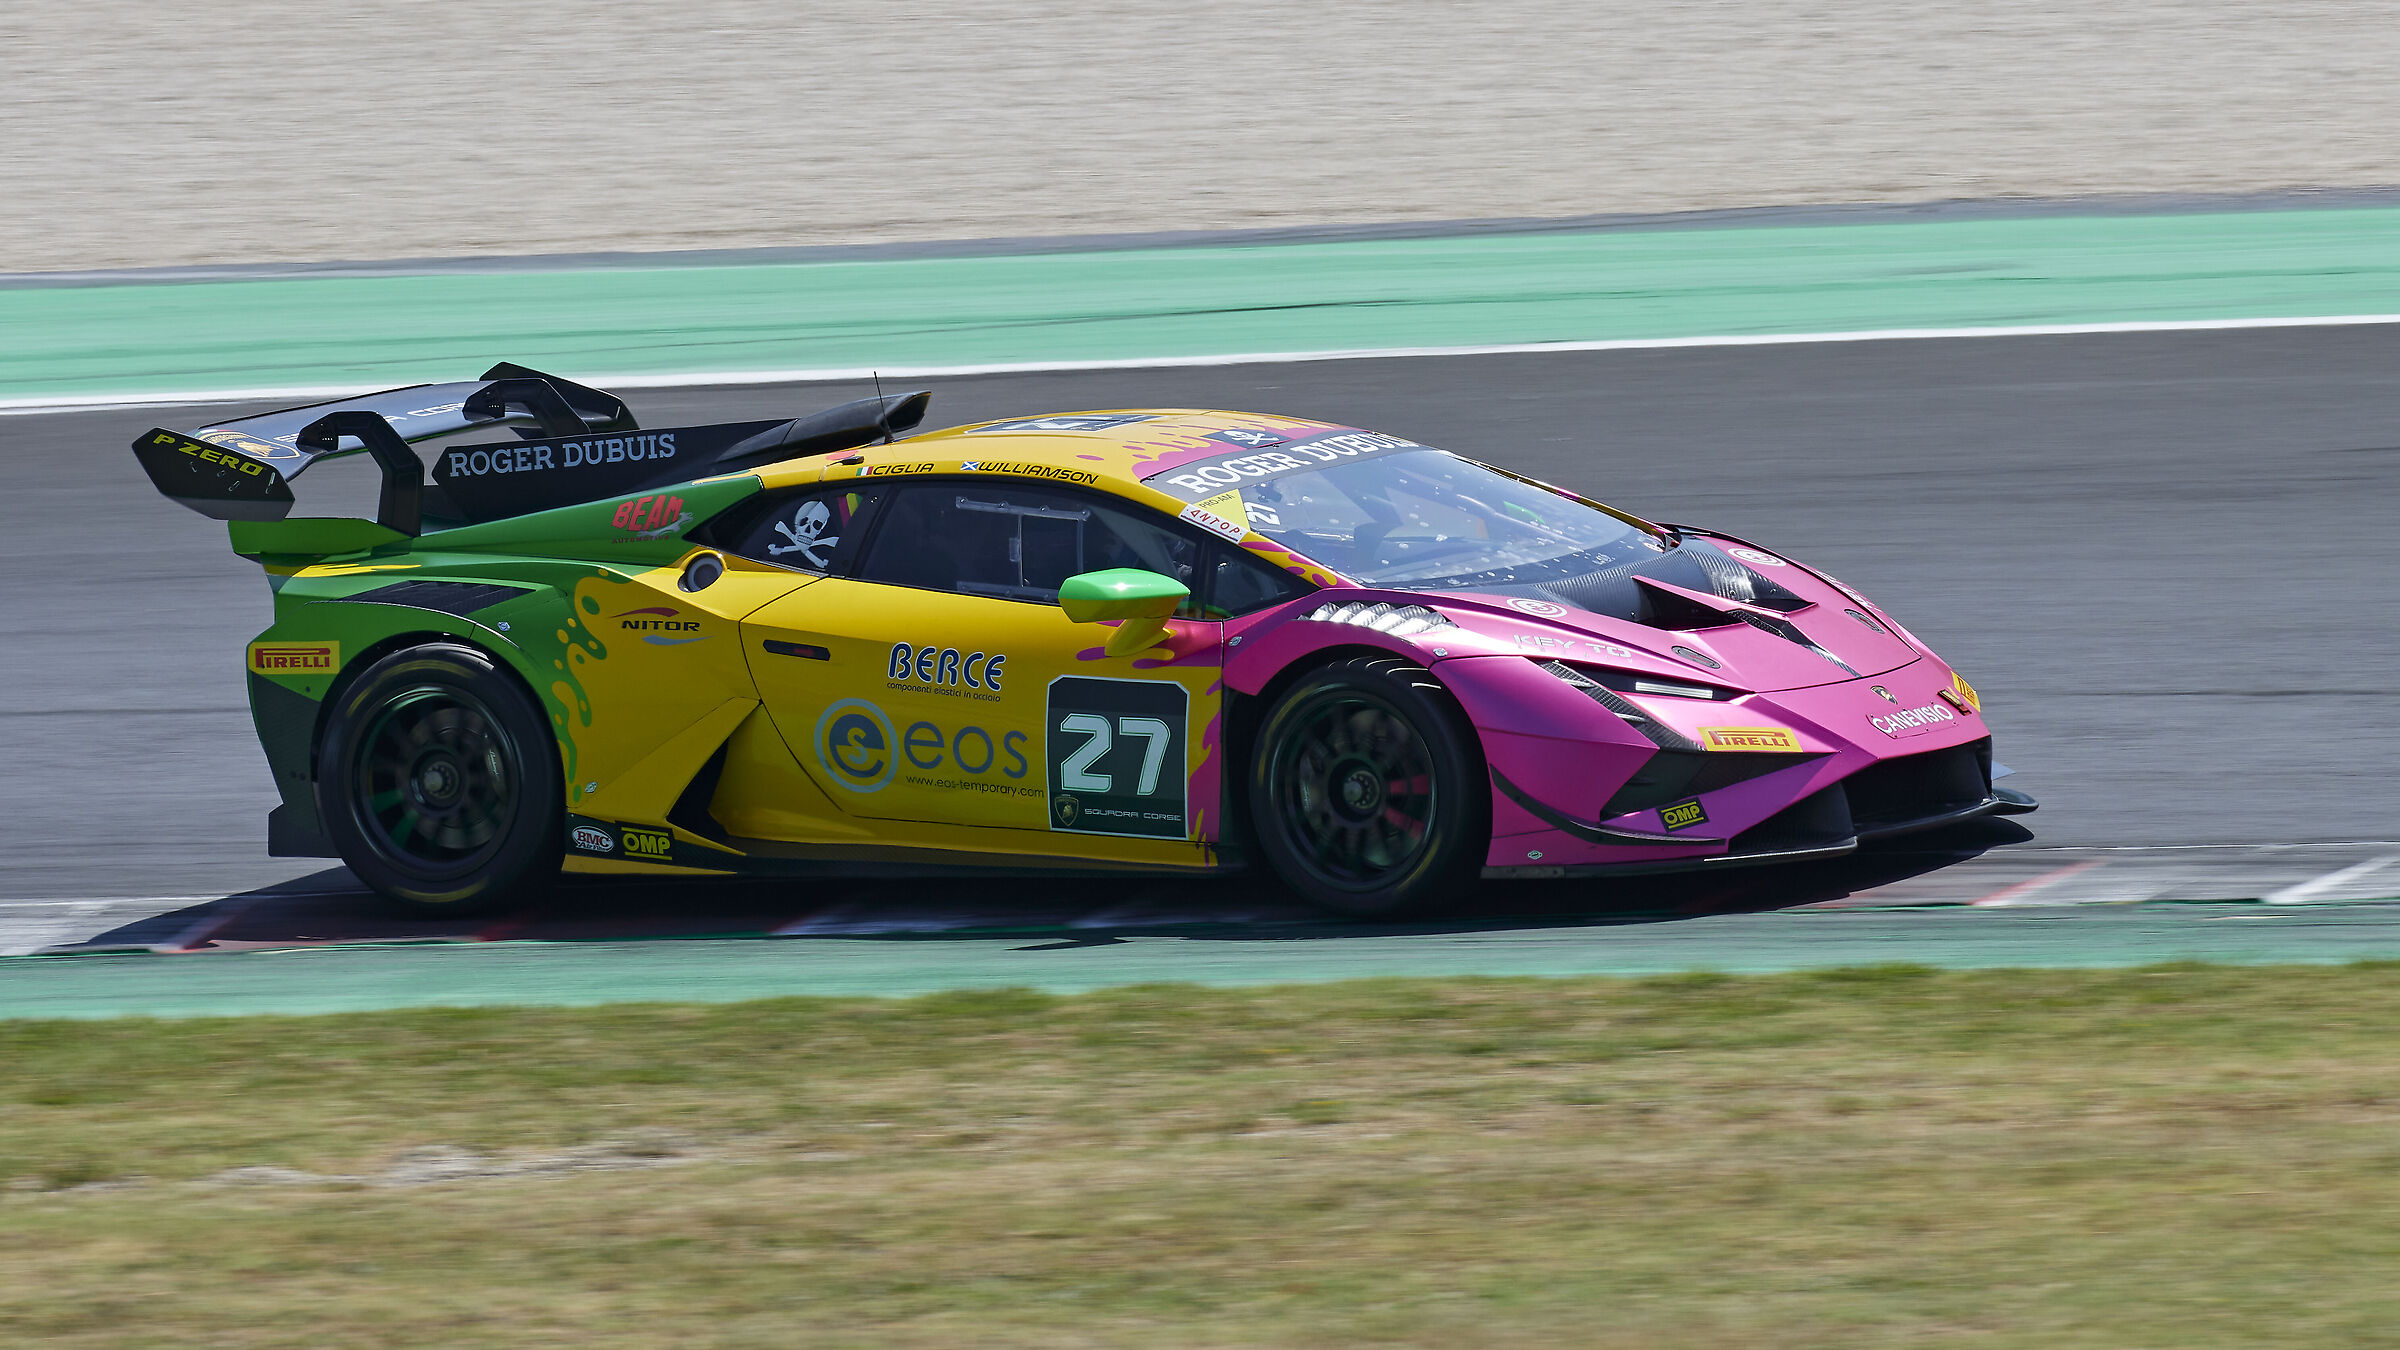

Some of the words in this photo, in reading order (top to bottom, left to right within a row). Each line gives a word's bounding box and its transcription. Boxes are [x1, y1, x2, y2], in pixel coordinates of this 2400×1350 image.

[153, 433, 176, 445] P
[178, 441, 264, 477] ZERO
[449, 445, 555, 477] ROGER
[562, 433, 676, 468] DUBUIS
[872, 463, 935, 476] CIGLIA
[978, 461, 1100, 485] WILLIAMSON
[1166, 452, 1313, 494] ROGER
[611, 494, 685, 532] BEAM
[622, 620, 701, 632] NITOR
[255, 647, 331, 669] PIRELLI
[1513, 634, 1576, 649] KEY
[1585, 642, 1632, 658] TO
[887, 641, 1007, 692] BERCE
[886, 682, 932, 694] componenti
[934, 687, 962, 698] elastici
[964, 690, 971, 699] in
[973, 692, 1001, 703] acciaio
[1872, 703, 1954, 734] CANEVISIO
[903, 720, 1028, 779] eos
[1707, 730, 1791, 747] PIRELLI
[1060, 712, 1171, 796] 27
[905, 775, 1045, 799] www.eos-temporary.com
[1084, 808, 1140, 819] SQUADRA
[1143, 811, 1182, 822] CORSE
[1663, 805, 1701, 825] OMP
[576, 830, 610, 848] BMC
[622, 832, 671, 855] OMP
